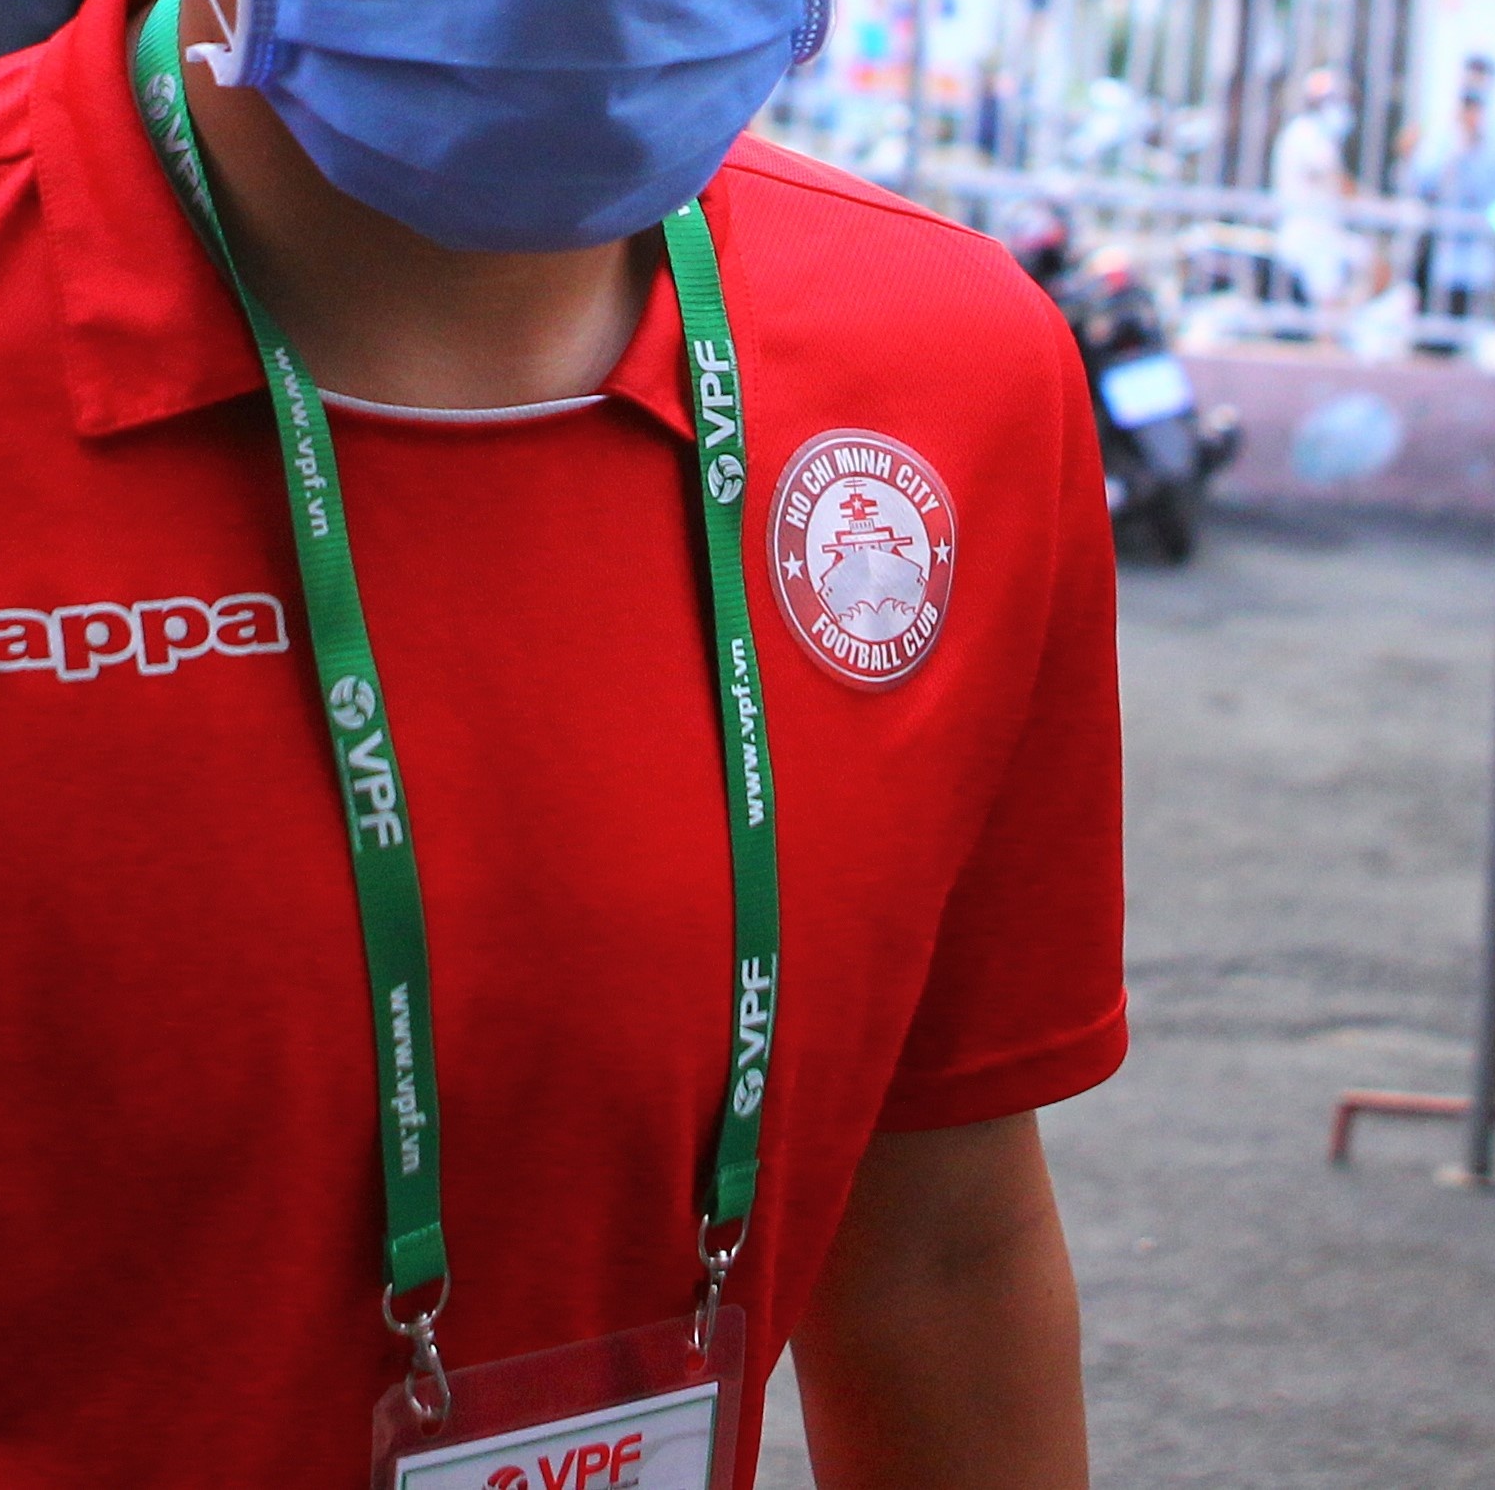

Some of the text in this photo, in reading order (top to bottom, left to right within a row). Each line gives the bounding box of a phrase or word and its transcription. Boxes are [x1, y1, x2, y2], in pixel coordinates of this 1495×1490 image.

[272, 346, 330, 538] www.vpf.vn
[694, 339, 737, 449] VPF
[785, 447, 940, 529] HO CHI MINH CITY
[811, 601, 939, 671] FOOTBALL CLUB
[348, 728, 403, 850] VPF
[730, 638, 764, 828] www.vpf.vn
[738, 956, 772, 1068] VPF
[389, 982, 426, 1176] www.vpf.vn
[537, 1432, 642, 1489] VPF
